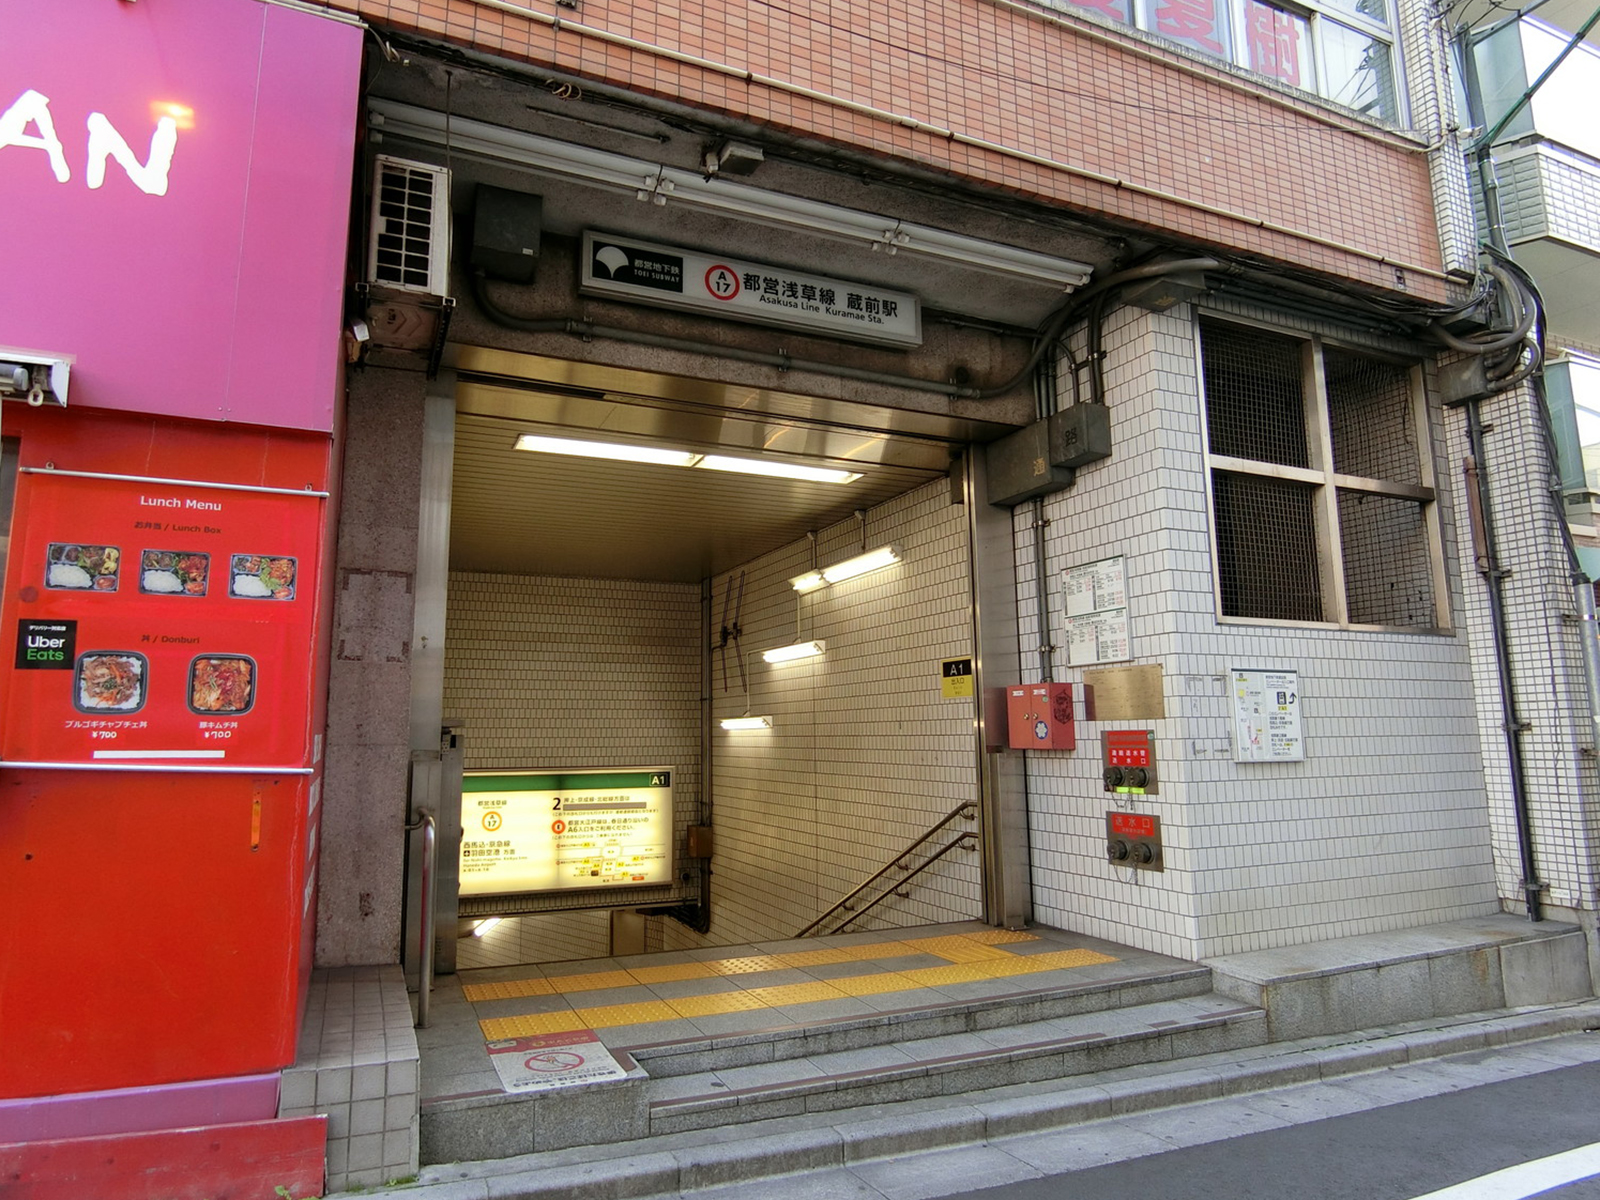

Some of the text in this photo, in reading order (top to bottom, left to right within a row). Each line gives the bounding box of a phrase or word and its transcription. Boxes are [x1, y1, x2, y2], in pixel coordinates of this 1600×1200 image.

[634, 259, 680, 275] 都営地下鉄
[634, 269, 680, 283] TOEI SUBWAY
[718, 272, 727, 281] A
[715, 282, 731, 293] 17
[743, 273, 898, 318] 都営浅草線 蔵前駅
[759, 295, 885, 325] Asakusa Line Kuramae Sta.
[140, 496, 222, 511] Lunch Menu
[134, 521, 162, 530] お弁当
[172, 524, 201, 533] Lunch
[204, 526, 221, 534] Box
[28, 635, 66, 648] Uber
[161, 635, 200, 644] Donburi
[27, 648, 64, 660] Eats
[950, 663, 963, 676] A1
[92, 731, 117, 739] ¥700
[204, 730, 232, 739] ¥700
[651, 775, 665, 785] A1
[552, 797, 561, 810] 2
